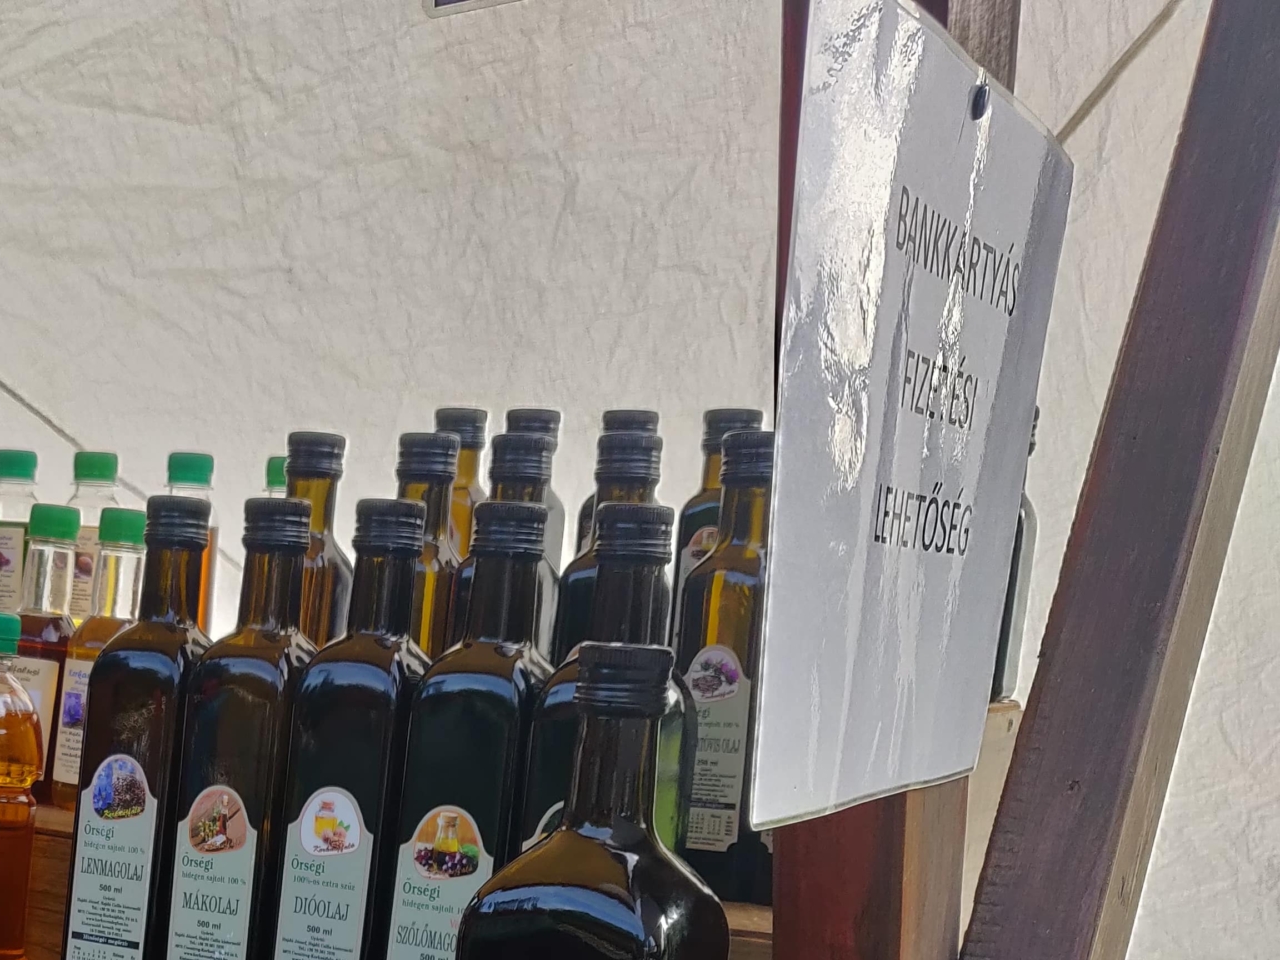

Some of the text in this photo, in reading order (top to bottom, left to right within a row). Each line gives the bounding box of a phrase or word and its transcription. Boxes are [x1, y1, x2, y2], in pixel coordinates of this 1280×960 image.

[874, 482, 973, 557] LEHETŐSÉG
[80, 856, 144, 882] LENMAGOLAJ
[182, 851, 214, 873] Őrségi
[291, 854, 326, 877] Őrségi
[98, 883, 123, 894] 500 ml
[402, 877, 441, 902] Őrségi
[182, 889, 240, 917] MÁKOLAJ
[293, 893, 350, 922] DIÓOLAJ
[196, 920, 222, 930] 500 ml
[306, 925, 333, 936] 500 ml
[396, 921, 458, 953] SZŐLŐMAGO
